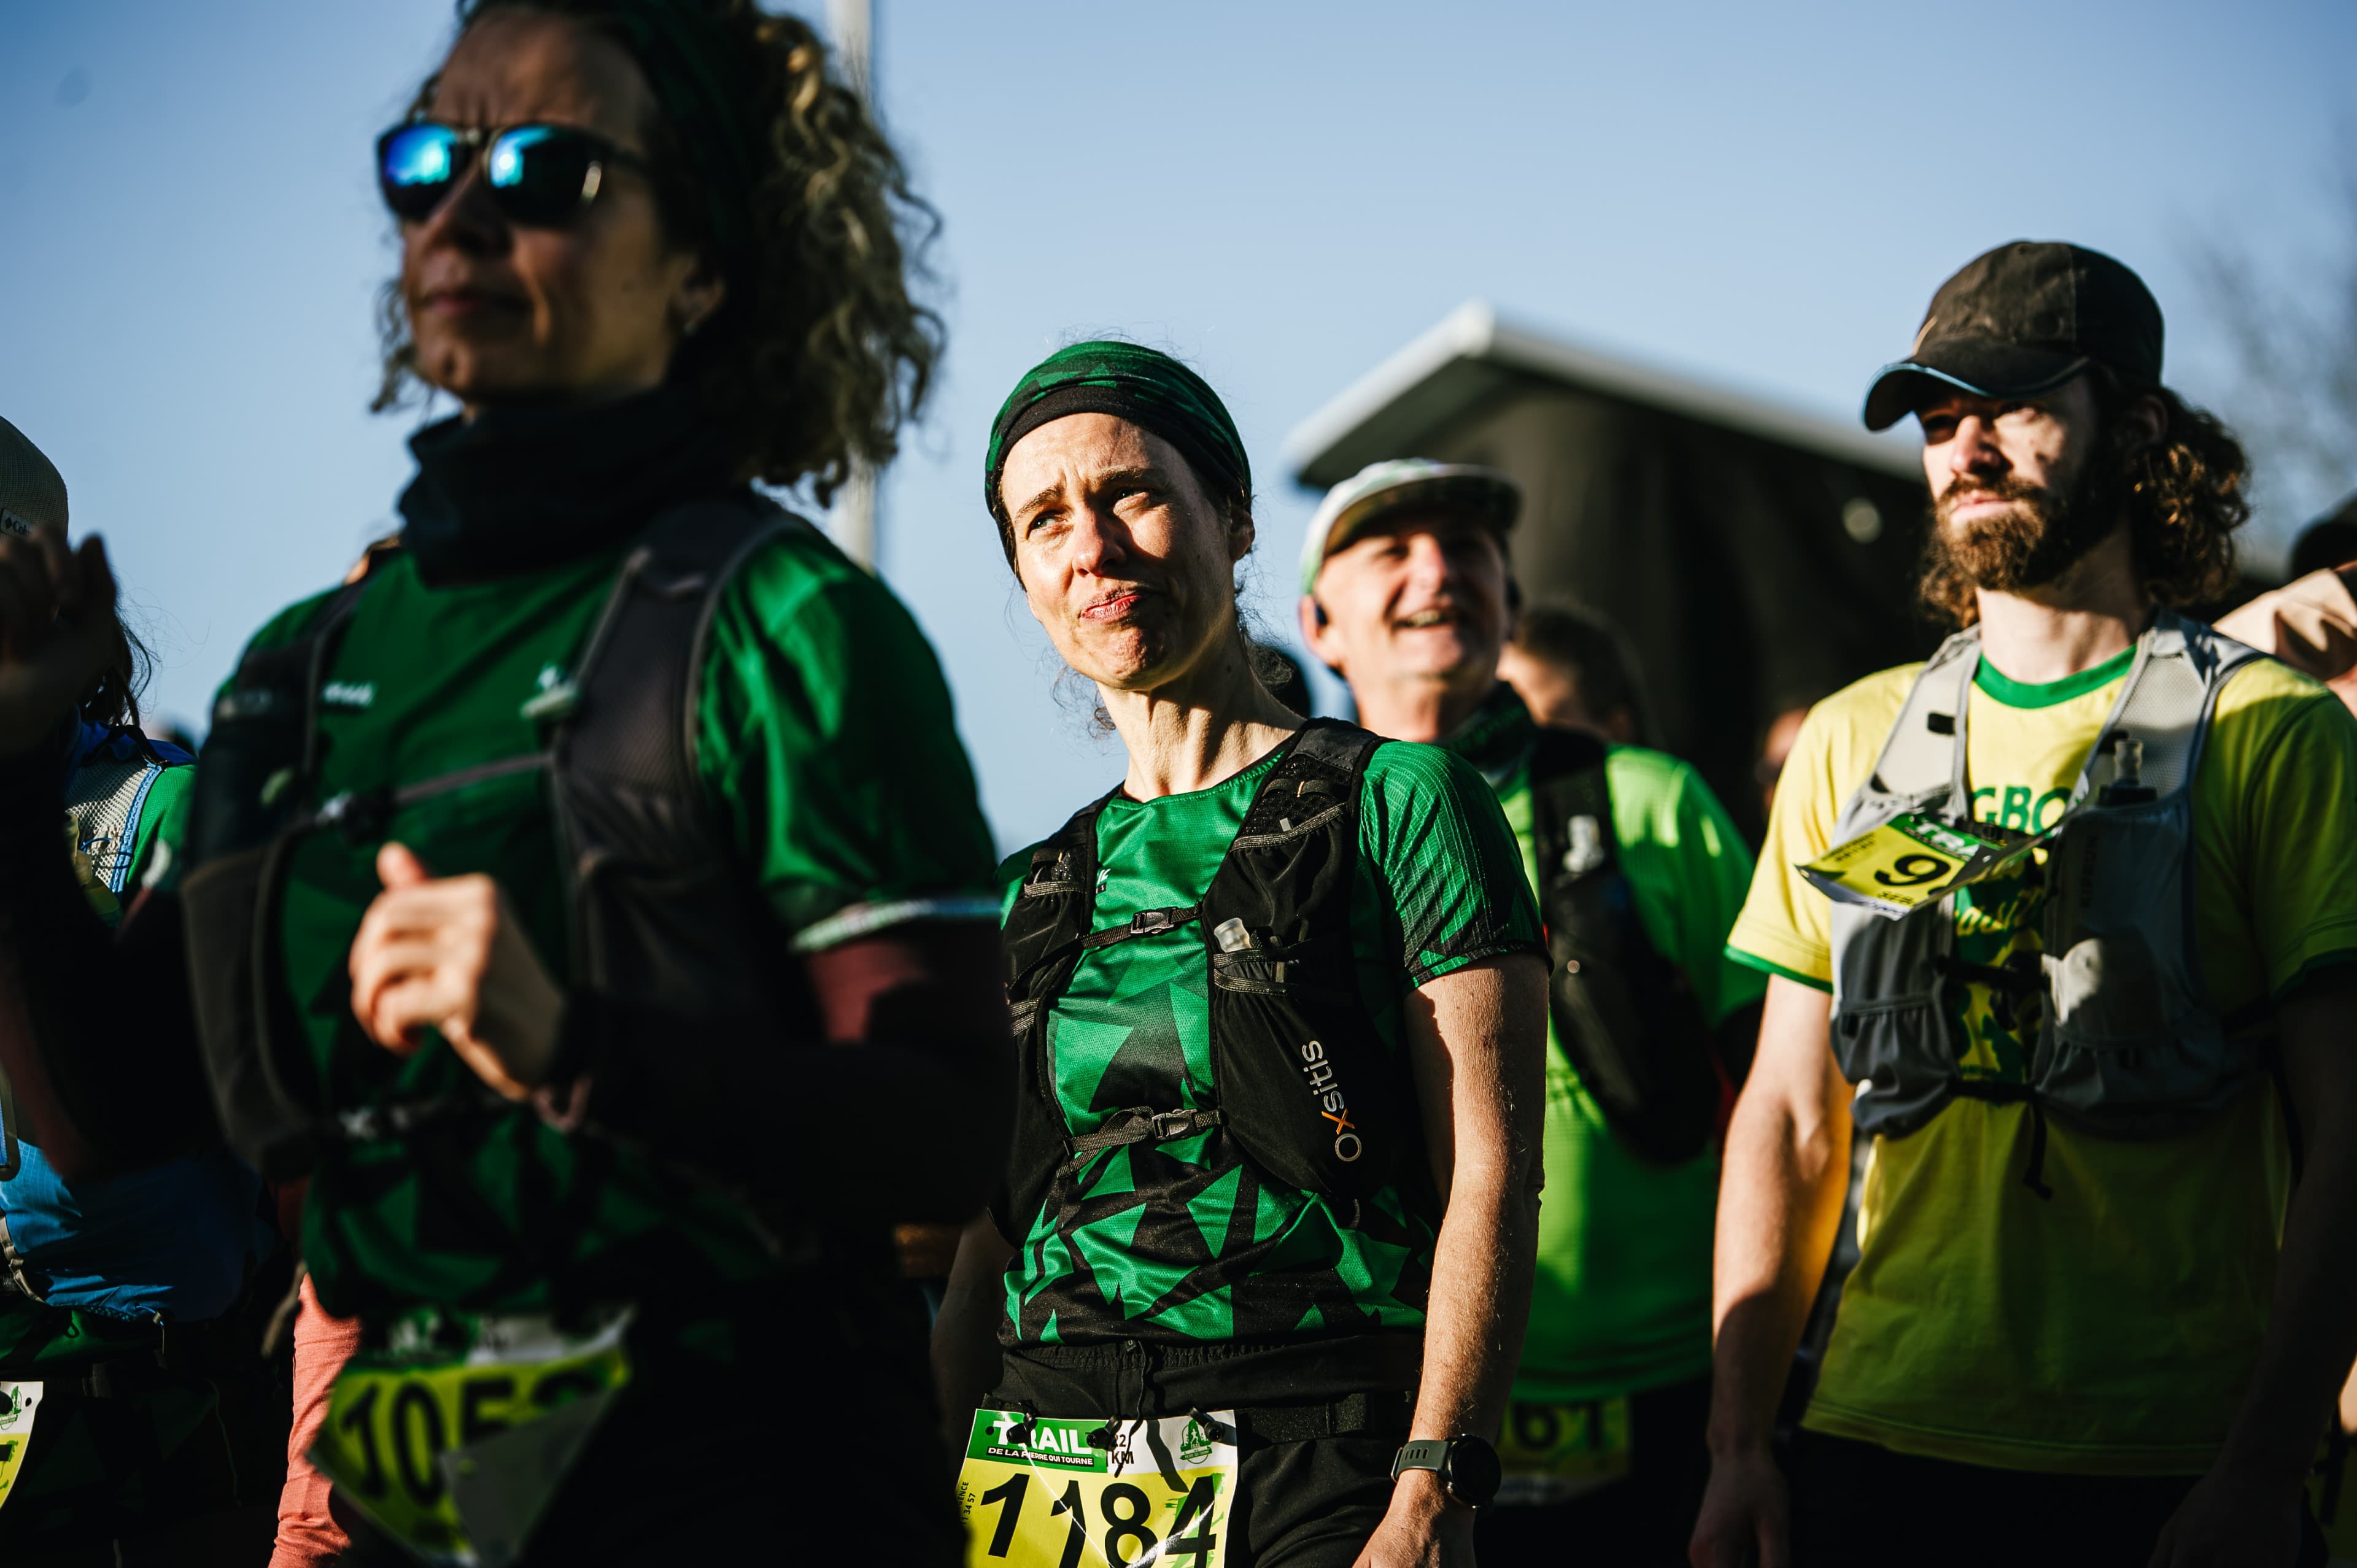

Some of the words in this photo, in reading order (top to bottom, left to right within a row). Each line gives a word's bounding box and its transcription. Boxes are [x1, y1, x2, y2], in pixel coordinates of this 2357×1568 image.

[1005, 1449, 1020, 1458] LA
[1061, 1456, 1093, 1465] TOURNE
[1112, 1451, 1134, 1464] KM
[967, 1493, 976, 1503] 57
[980, 1473, 1217, 1568] 1184
